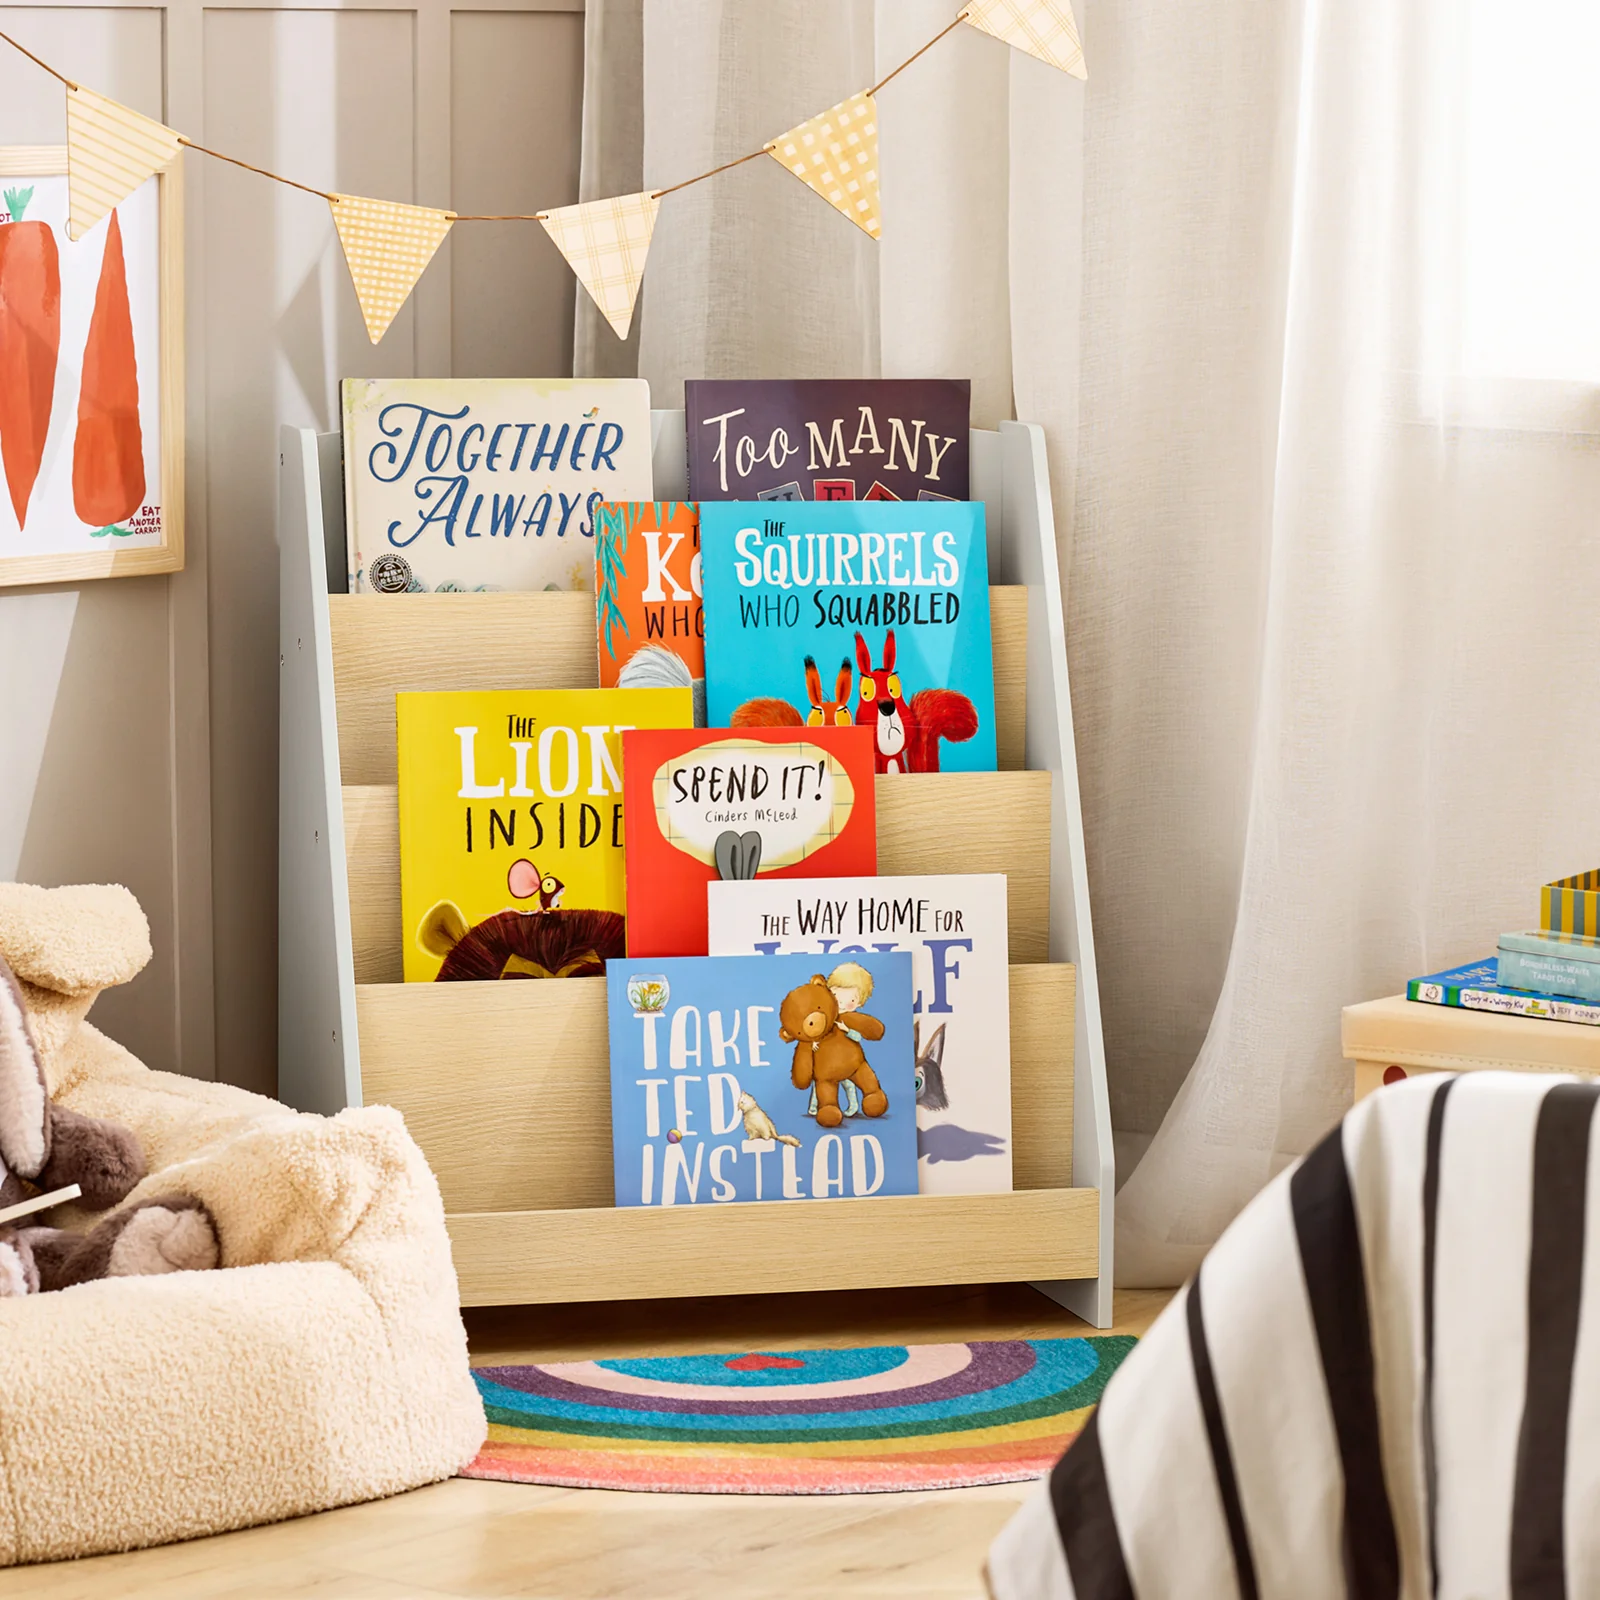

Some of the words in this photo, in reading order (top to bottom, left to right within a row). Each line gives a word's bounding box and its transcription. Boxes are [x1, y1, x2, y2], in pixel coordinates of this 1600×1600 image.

[368, 402, 624, 483] TOGETHER
[703, 407, 799, 491] Too
[804, 406, 957, 481] MANY
[134, 527, 161, 535] CARROT
[141, 506, 161, 516] EAT
[387, 474, 604, 548] ALWAYS
[763, 519, 786, 538] THE
[733, 527, 960, 589] SQUIRRELS
[739, 593, 800, 628] WHO
[813, 589, 960, 629] SQUABBLED
[506, 714, 537, 739] THE
[453, 725, 623, 799] LION
[672, 763, 769, 804] SPEND
[781, 760, 825, 801] IT!
[466, 802, 624, 853] INSIDE
[705, 810, 748, 823] Cinders
[761, 914, 790, 936] THE
[796, 898, 848, 936] WAY
[857, 897, 930, 935] HOME
[934, 909, 964, 933] FOR
[1464, 993, 1481, 1004] Diary
[633, 1005, 774, 1071] TAKE
[636, 1072, 743, 1138] TED
[641, 1133, 885, 1206] INSTEAD
